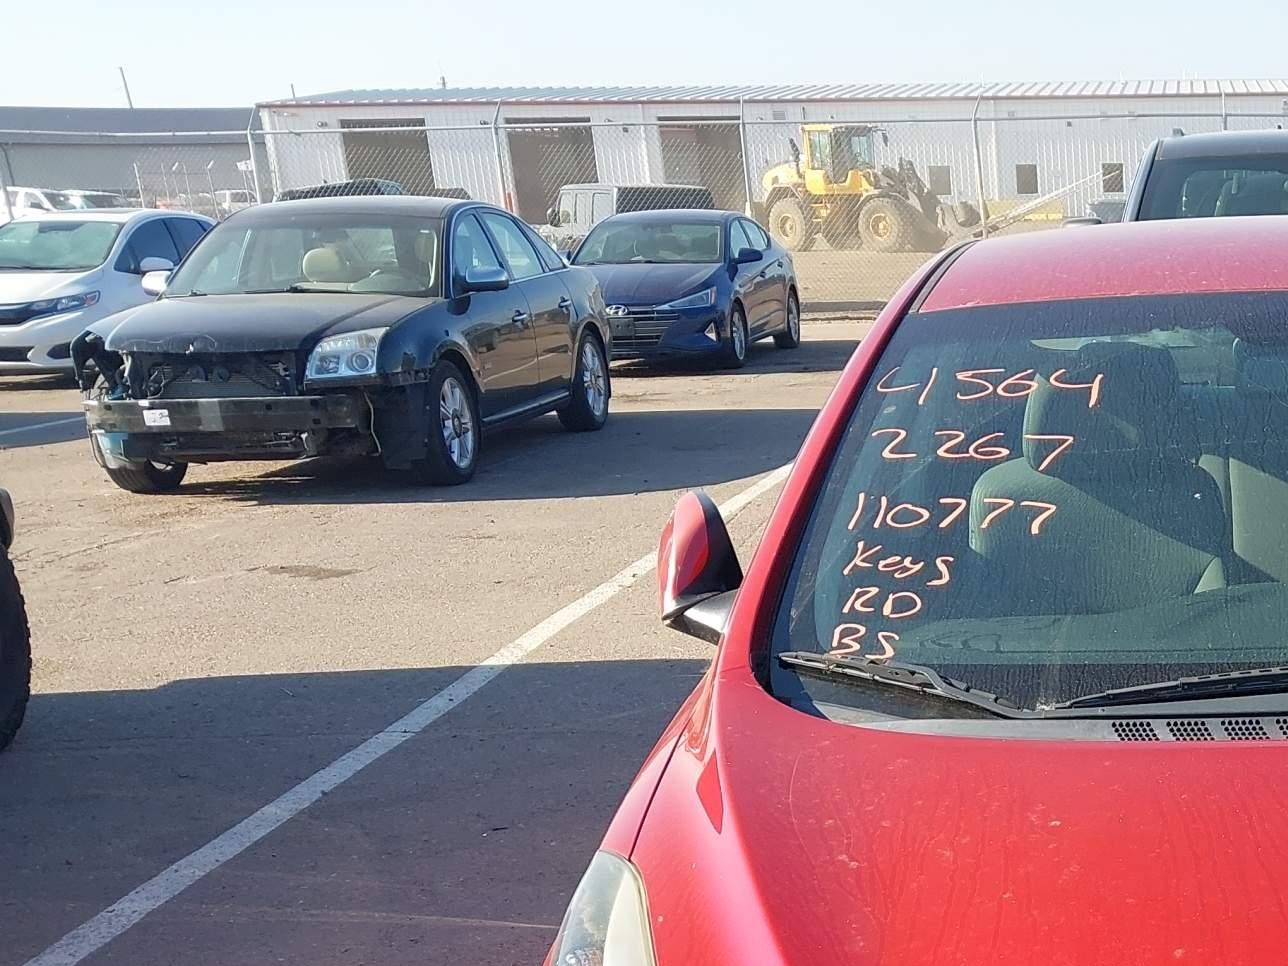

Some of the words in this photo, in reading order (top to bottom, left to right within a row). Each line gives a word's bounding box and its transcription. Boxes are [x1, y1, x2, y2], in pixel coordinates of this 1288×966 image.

[876, 366, 1104, 408] 4564
[871, 428, 1075, 471] 2267
[847, 492, 1057, 535] 110777
